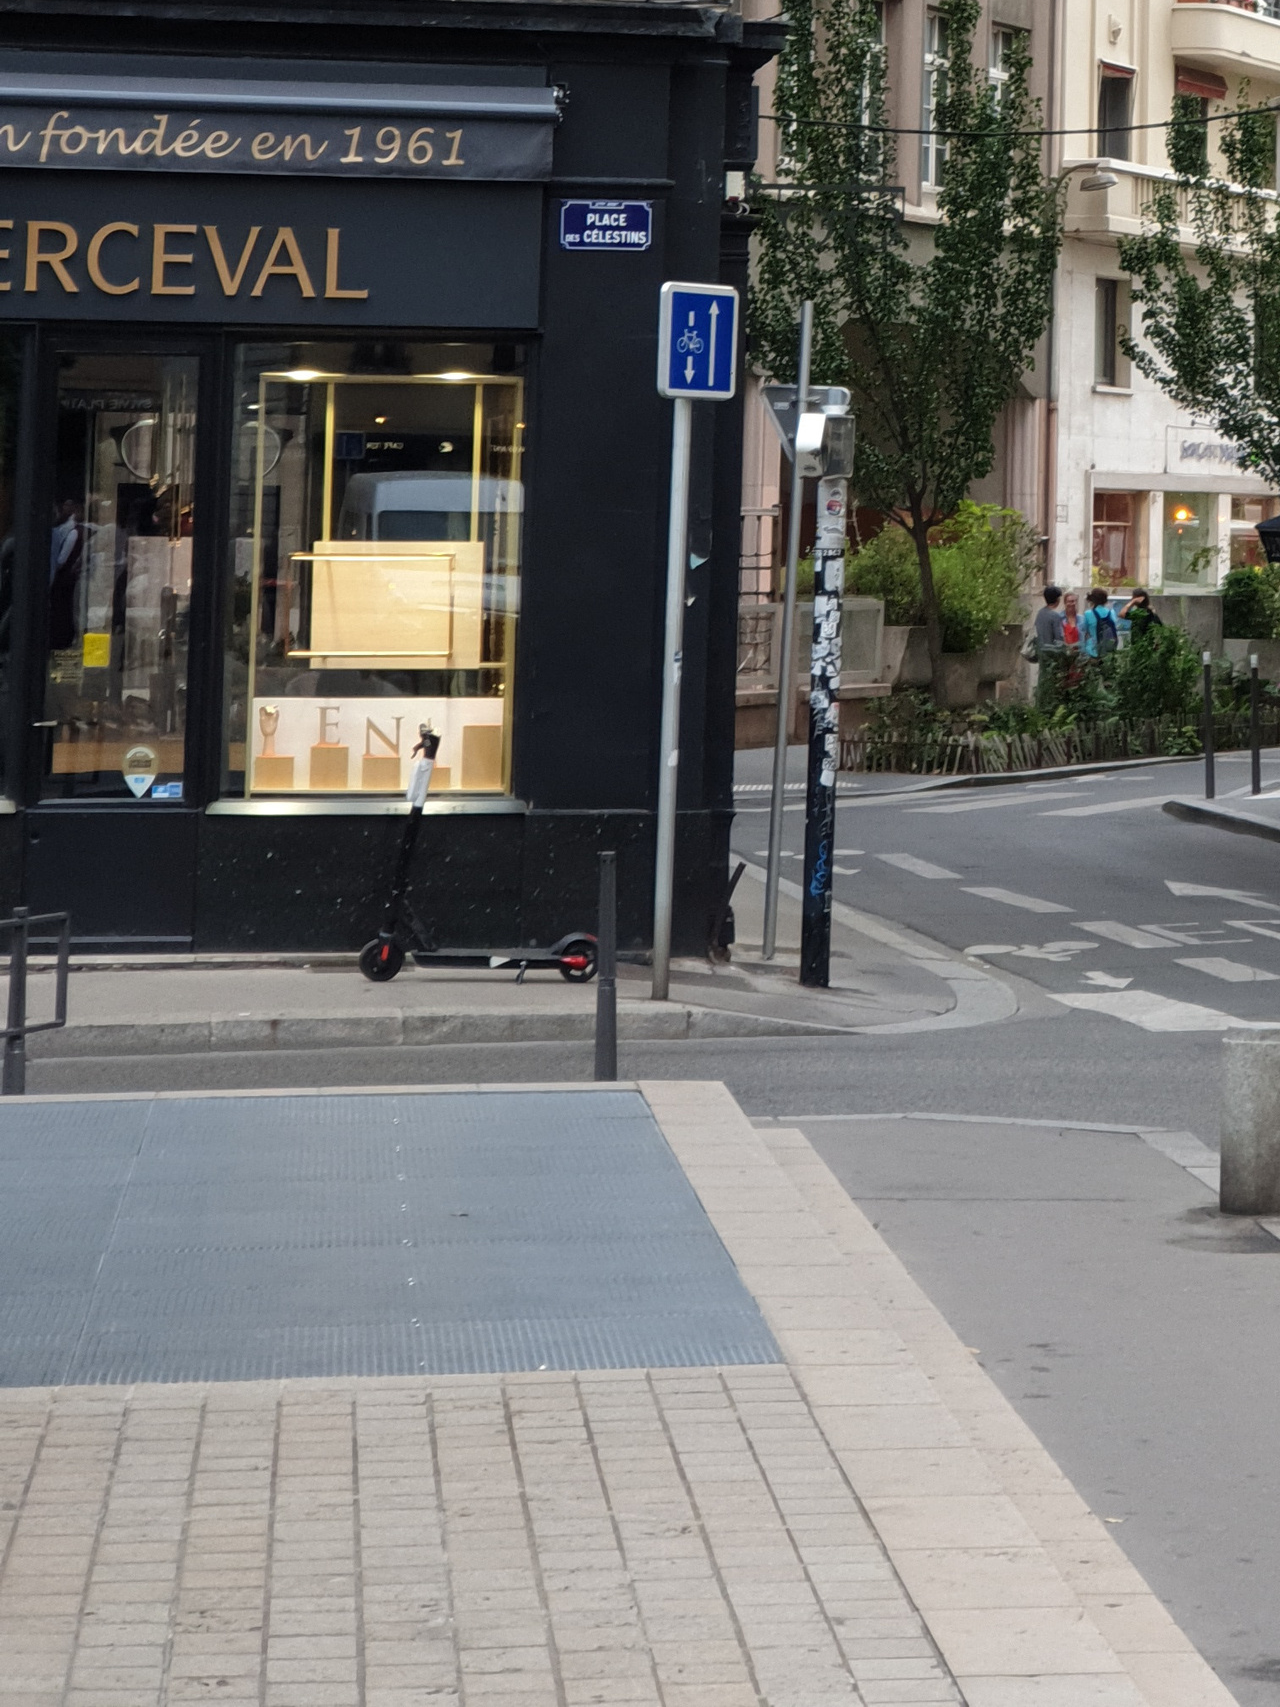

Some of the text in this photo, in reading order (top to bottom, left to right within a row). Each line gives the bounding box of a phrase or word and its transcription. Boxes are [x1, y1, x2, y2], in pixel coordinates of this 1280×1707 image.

[38, 110, 242, 163] fondée
[251, 131, 329, 162] en
[339, 125, 465, 167] 1961
[583, 229, 647, 244] CÉLESTINS
[586, 213, 628, 227] PLACE
[0, 219, 369, 299] RCEVAL
